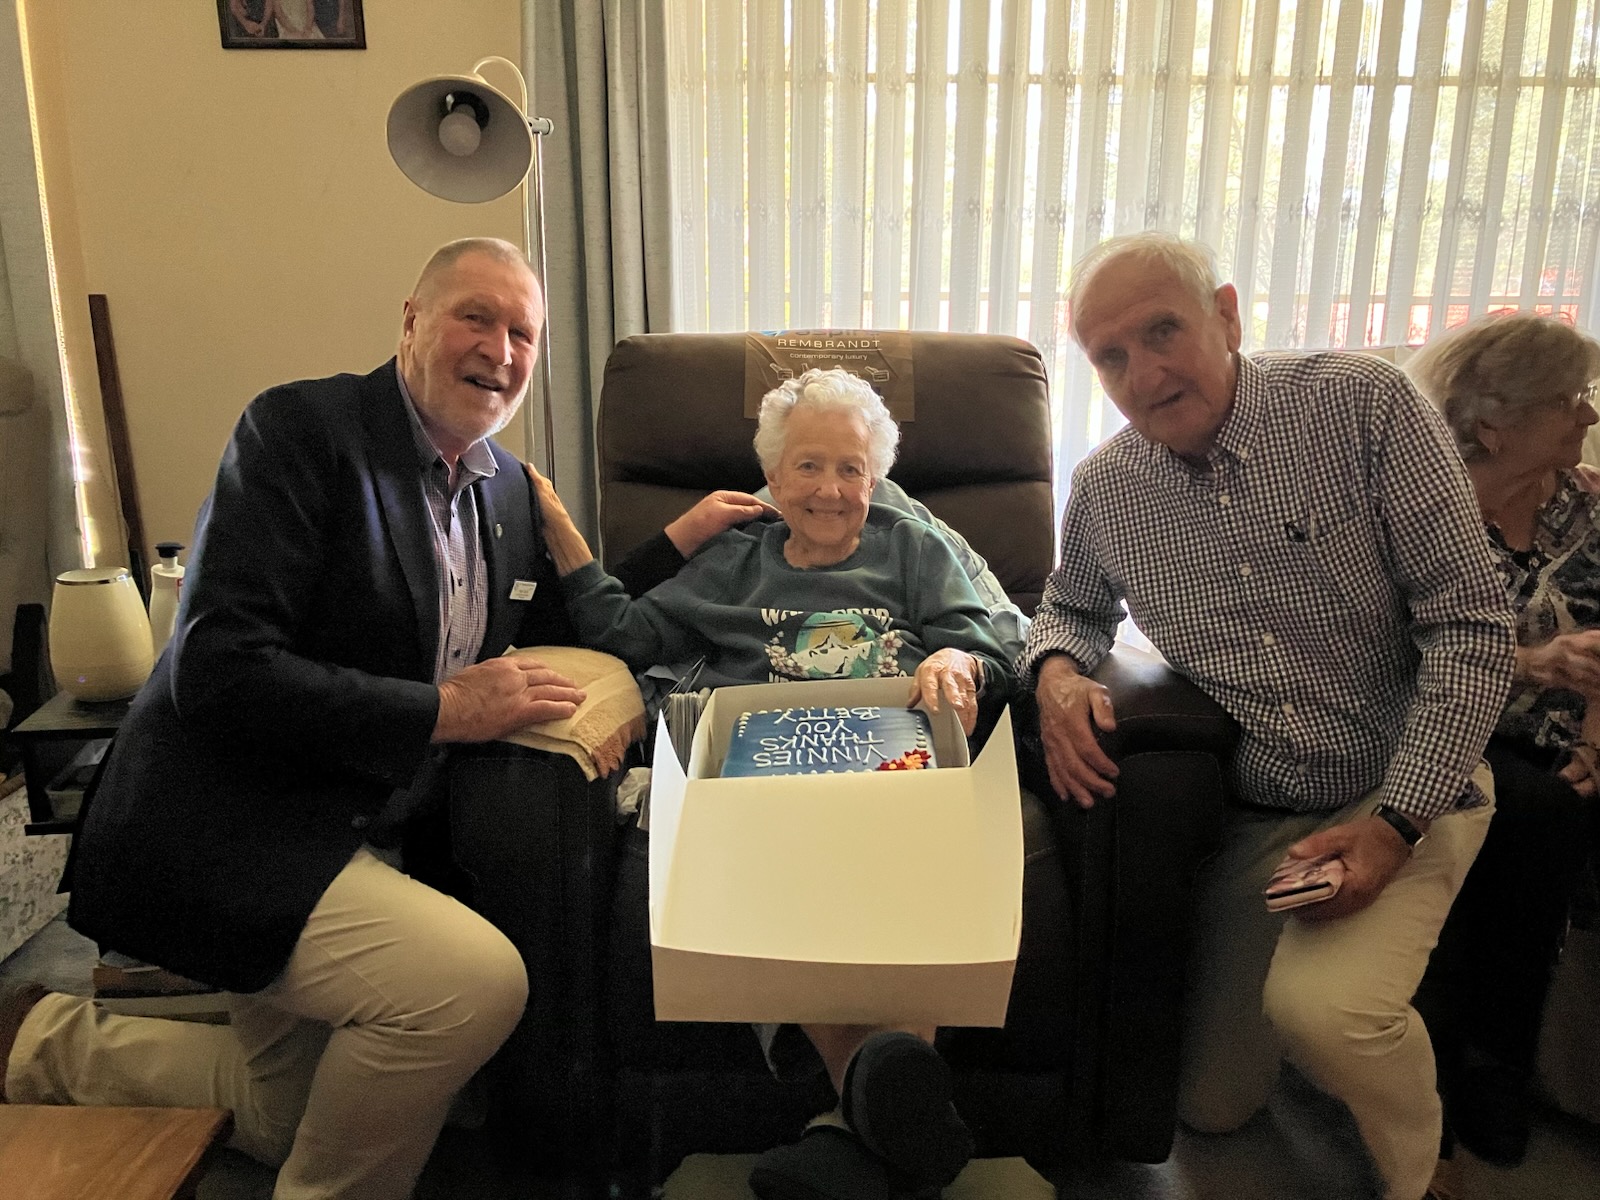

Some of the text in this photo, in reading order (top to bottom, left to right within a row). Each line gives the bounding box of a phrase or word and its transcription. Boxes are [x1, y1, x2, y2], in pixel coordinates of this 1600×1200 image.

[777, 338, 880, 348] REMBRANDT
[790, 353, 843, 361] contemporary
[774, 706, 881, 724] BETTY
[795, 719, 852, 735] YOU
[760, 731, 885, 751] THANKS
[752, 745, 888, 767] VINNIES
